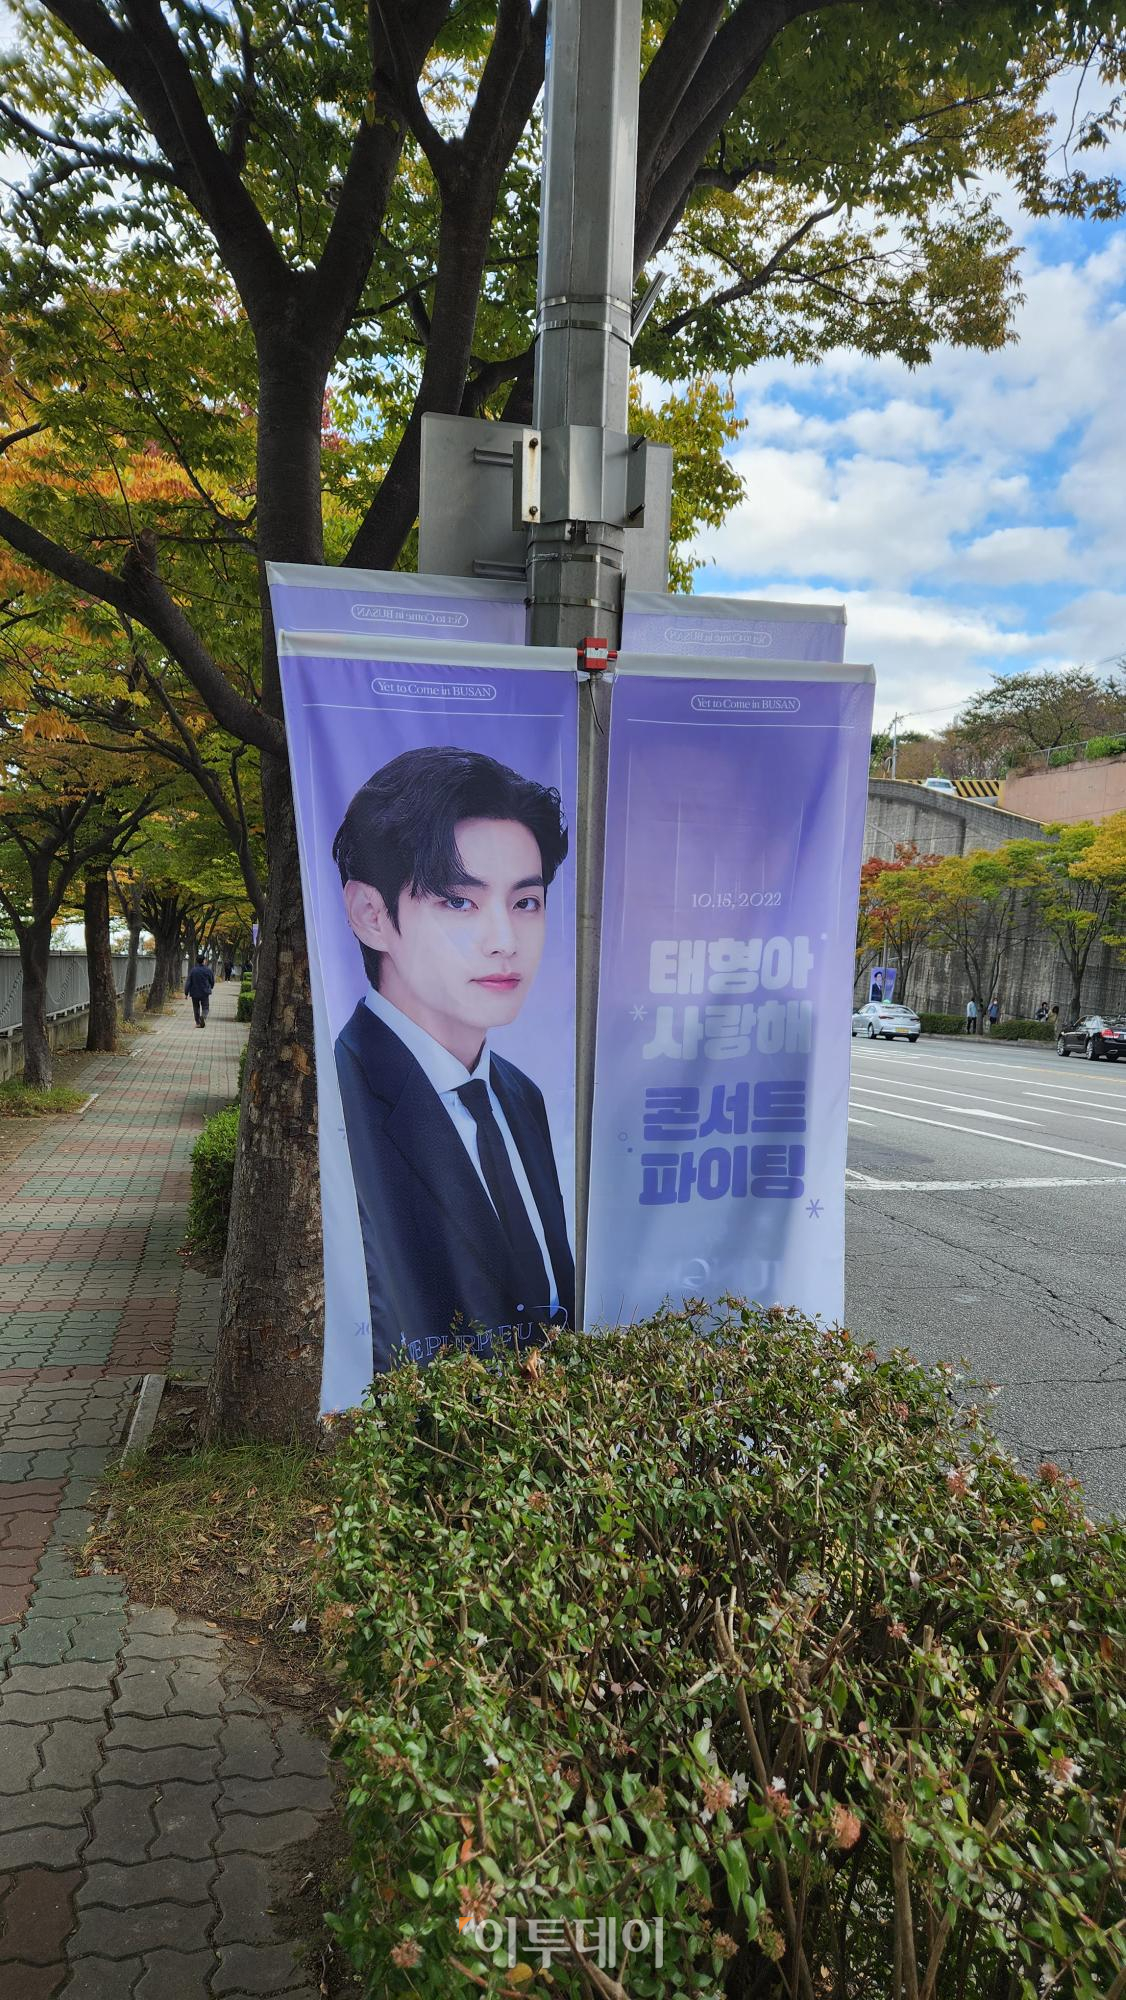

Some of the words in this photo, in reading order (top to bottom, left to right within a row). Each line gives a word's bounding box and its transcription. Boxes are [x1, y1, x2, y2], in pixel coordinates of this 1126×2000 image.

[377, 681, 394, 692] Yet
[396, 683, 407, 693] to
[408, 684, 440, 695] Come
[441, 685, 450, 696] in
[452, 686, 491, 697] BUSAN
[697, 698, 710, 708] Yet
[712, 699, 722, 708] to
[723, 699, 750, 709] Come
[751, 700, 760, 709] in
[762, 700, 796, 709] BUSAN
[649, 936, 814, 994] 태형아
[642, 1000, 813, 1060] 사랑해
[643, 1080, 806, 1141] 콘서트
[638, 1144, 805, 1205] 파이팅
